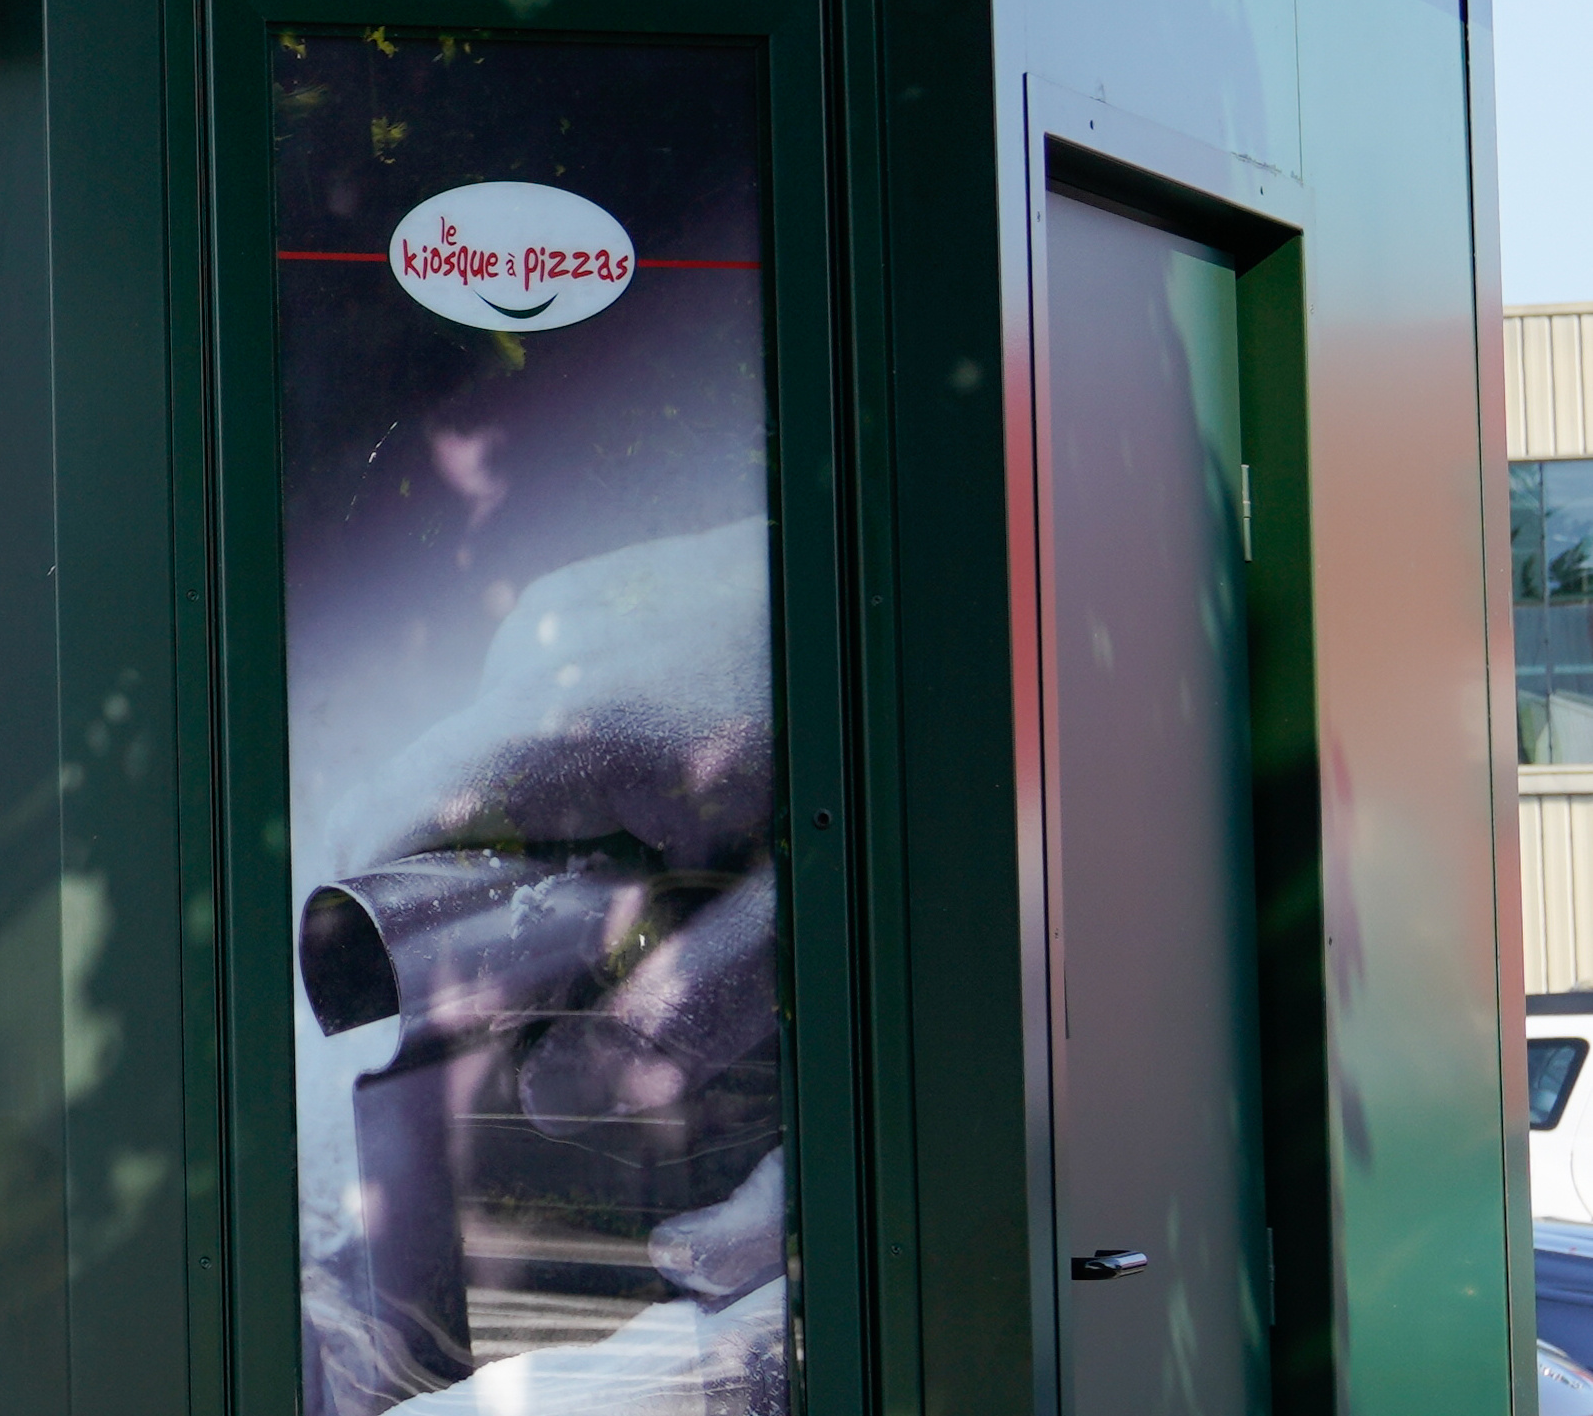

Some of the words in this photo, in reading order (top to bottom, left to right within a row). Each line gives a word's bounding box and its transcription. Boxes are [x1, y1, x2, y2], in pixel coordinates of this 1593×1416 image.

[441, 216, 457, 246] le
[403, 239, 499, 286] kiosque
[506, 252, 516, 277] à
[524, 247, 629, 291] pizzas
